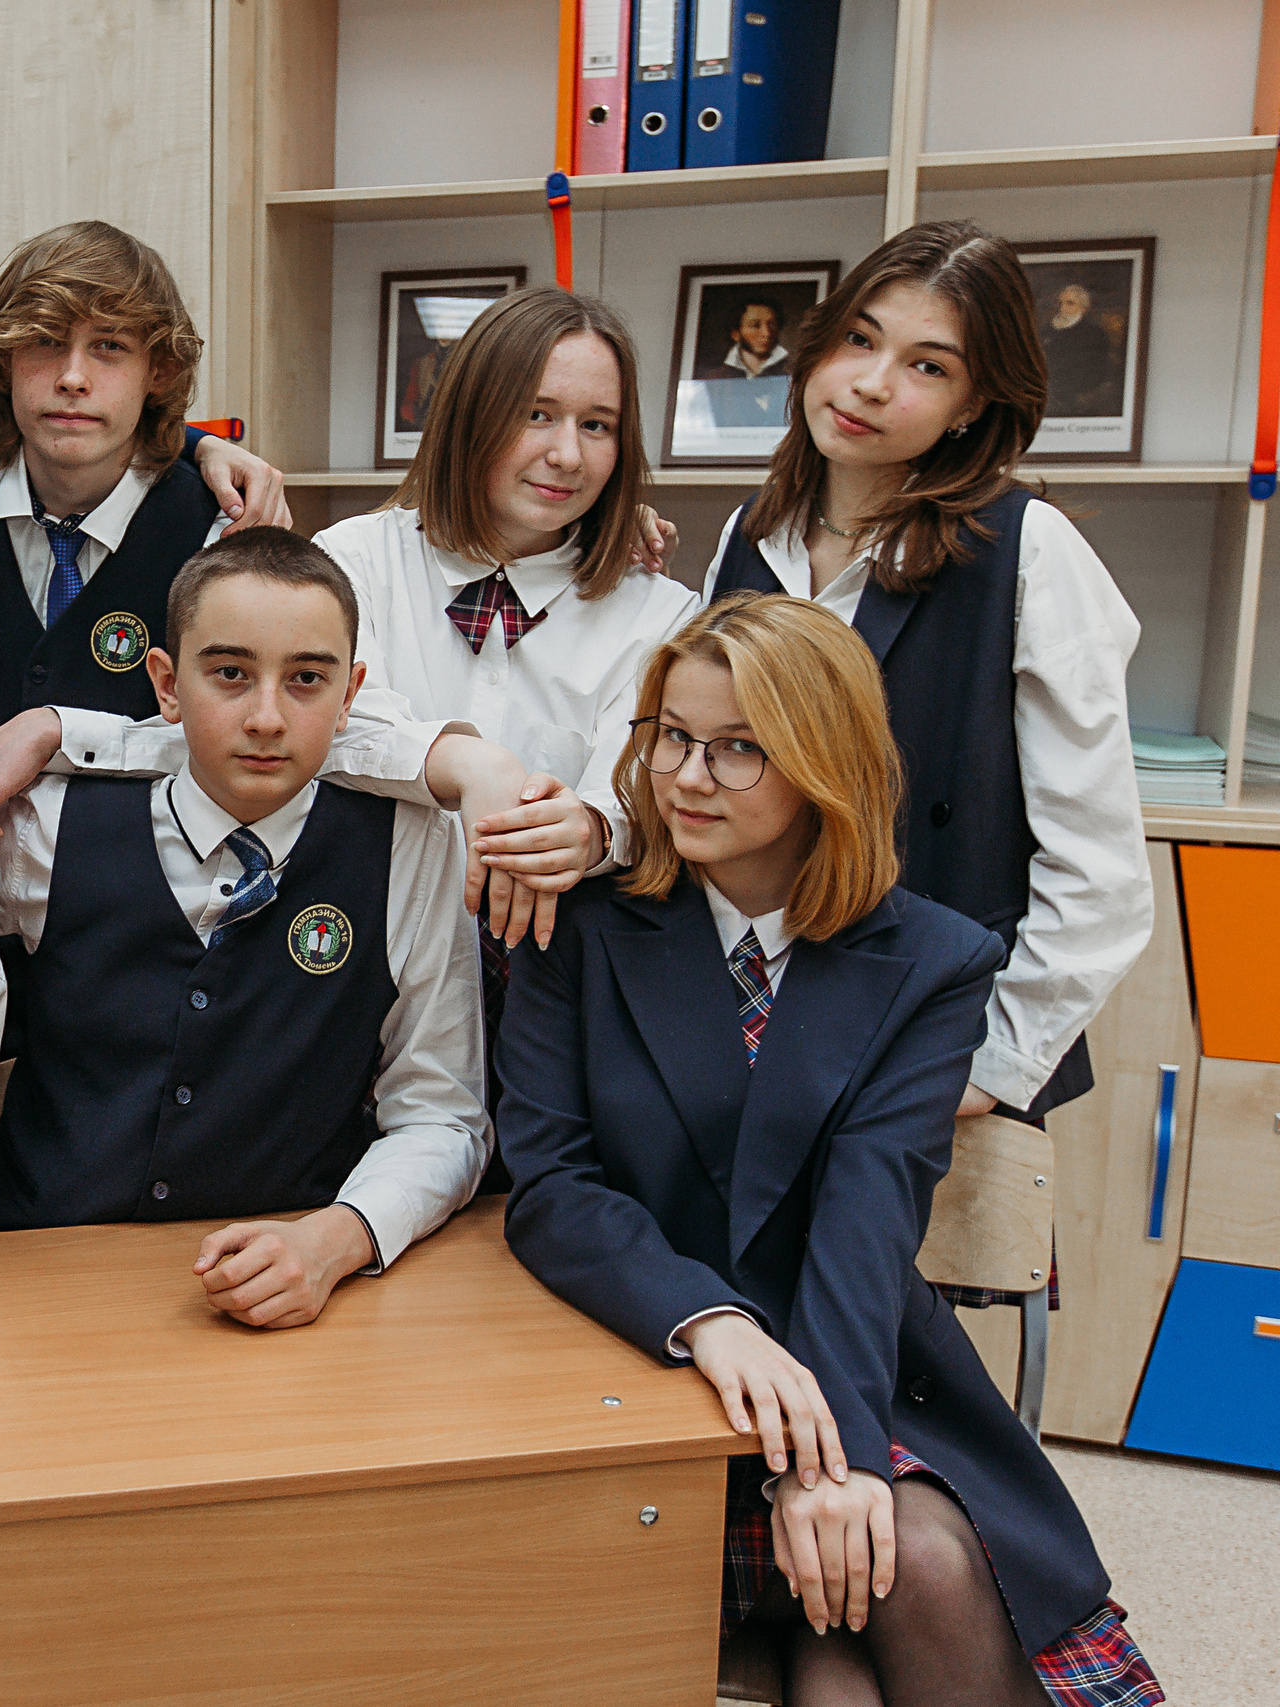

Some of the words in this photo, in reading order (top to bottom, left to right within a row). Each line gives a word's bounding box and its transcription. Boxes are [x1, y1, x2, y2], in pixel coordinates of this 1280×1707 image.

[96, 615, 137, 636] ГИМНАЗИЯ
[102, 657, 131, 668] Тюмень
[293, 909, 336, 935] ГИМНАЗИЯ
[335, 917, 345, 930] №
[341, 930, 348, 942] 16
[303, 957, 337, 970] Тюмень
